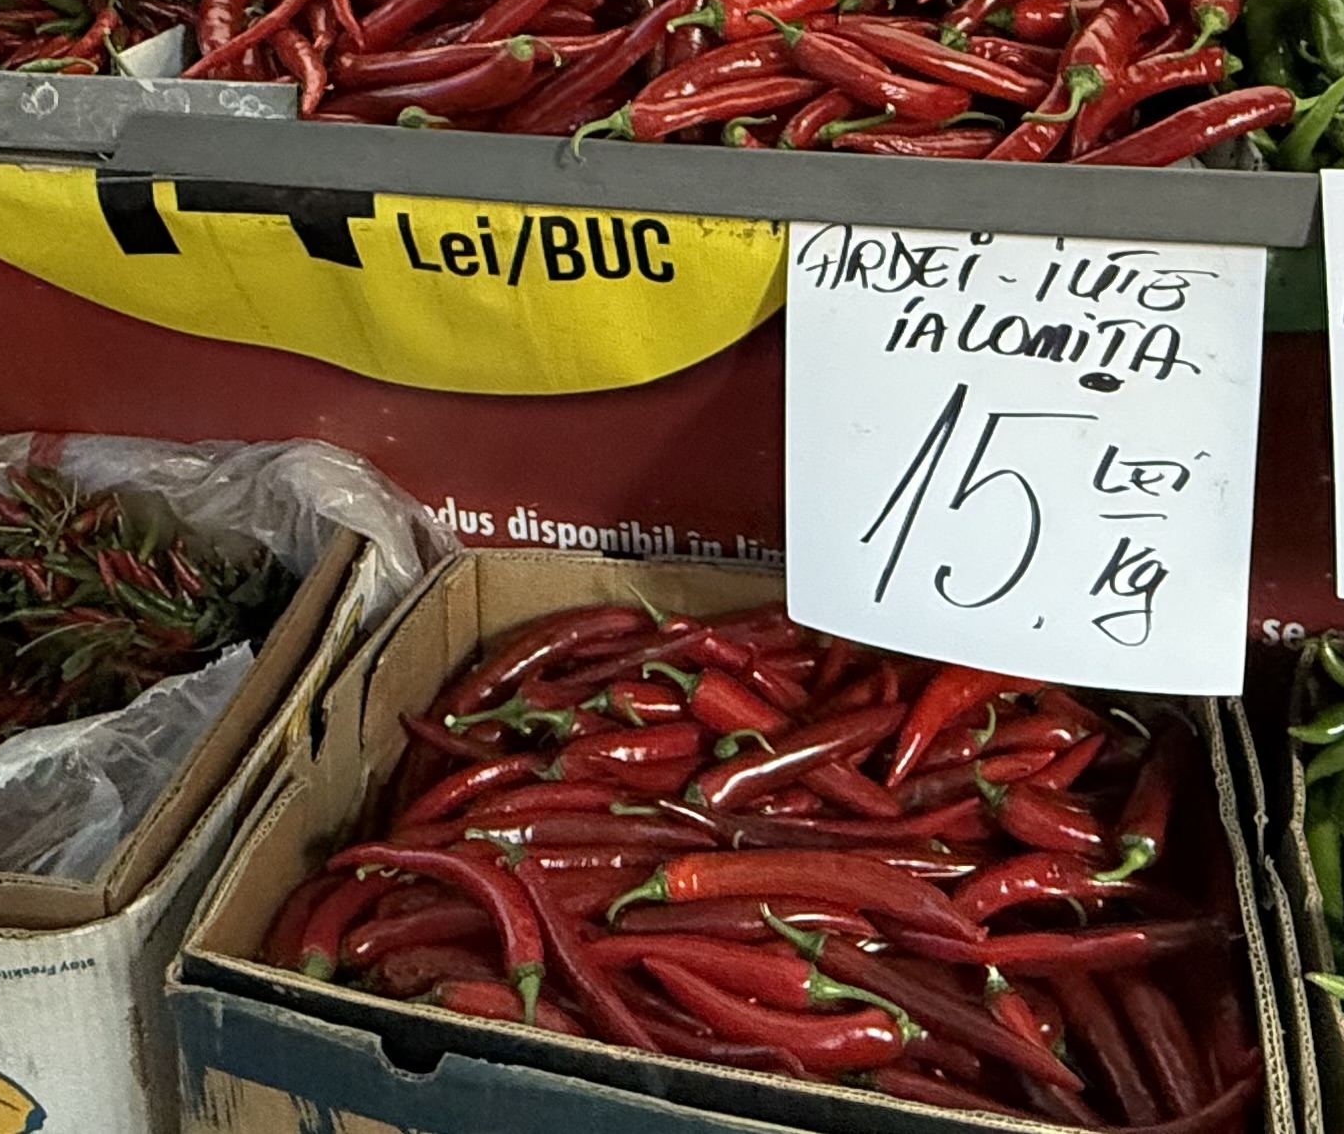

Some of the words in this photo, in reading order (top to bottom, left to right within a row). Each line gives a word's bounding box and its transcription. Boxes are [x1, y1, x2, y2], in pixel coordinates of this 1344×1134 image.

[396, 212, 675, 287] Lei/BUC
[860, 383, 1099, 608] 15
[507, 505, 675, 555] disponibil
[59, 958, 96, 973] stay
